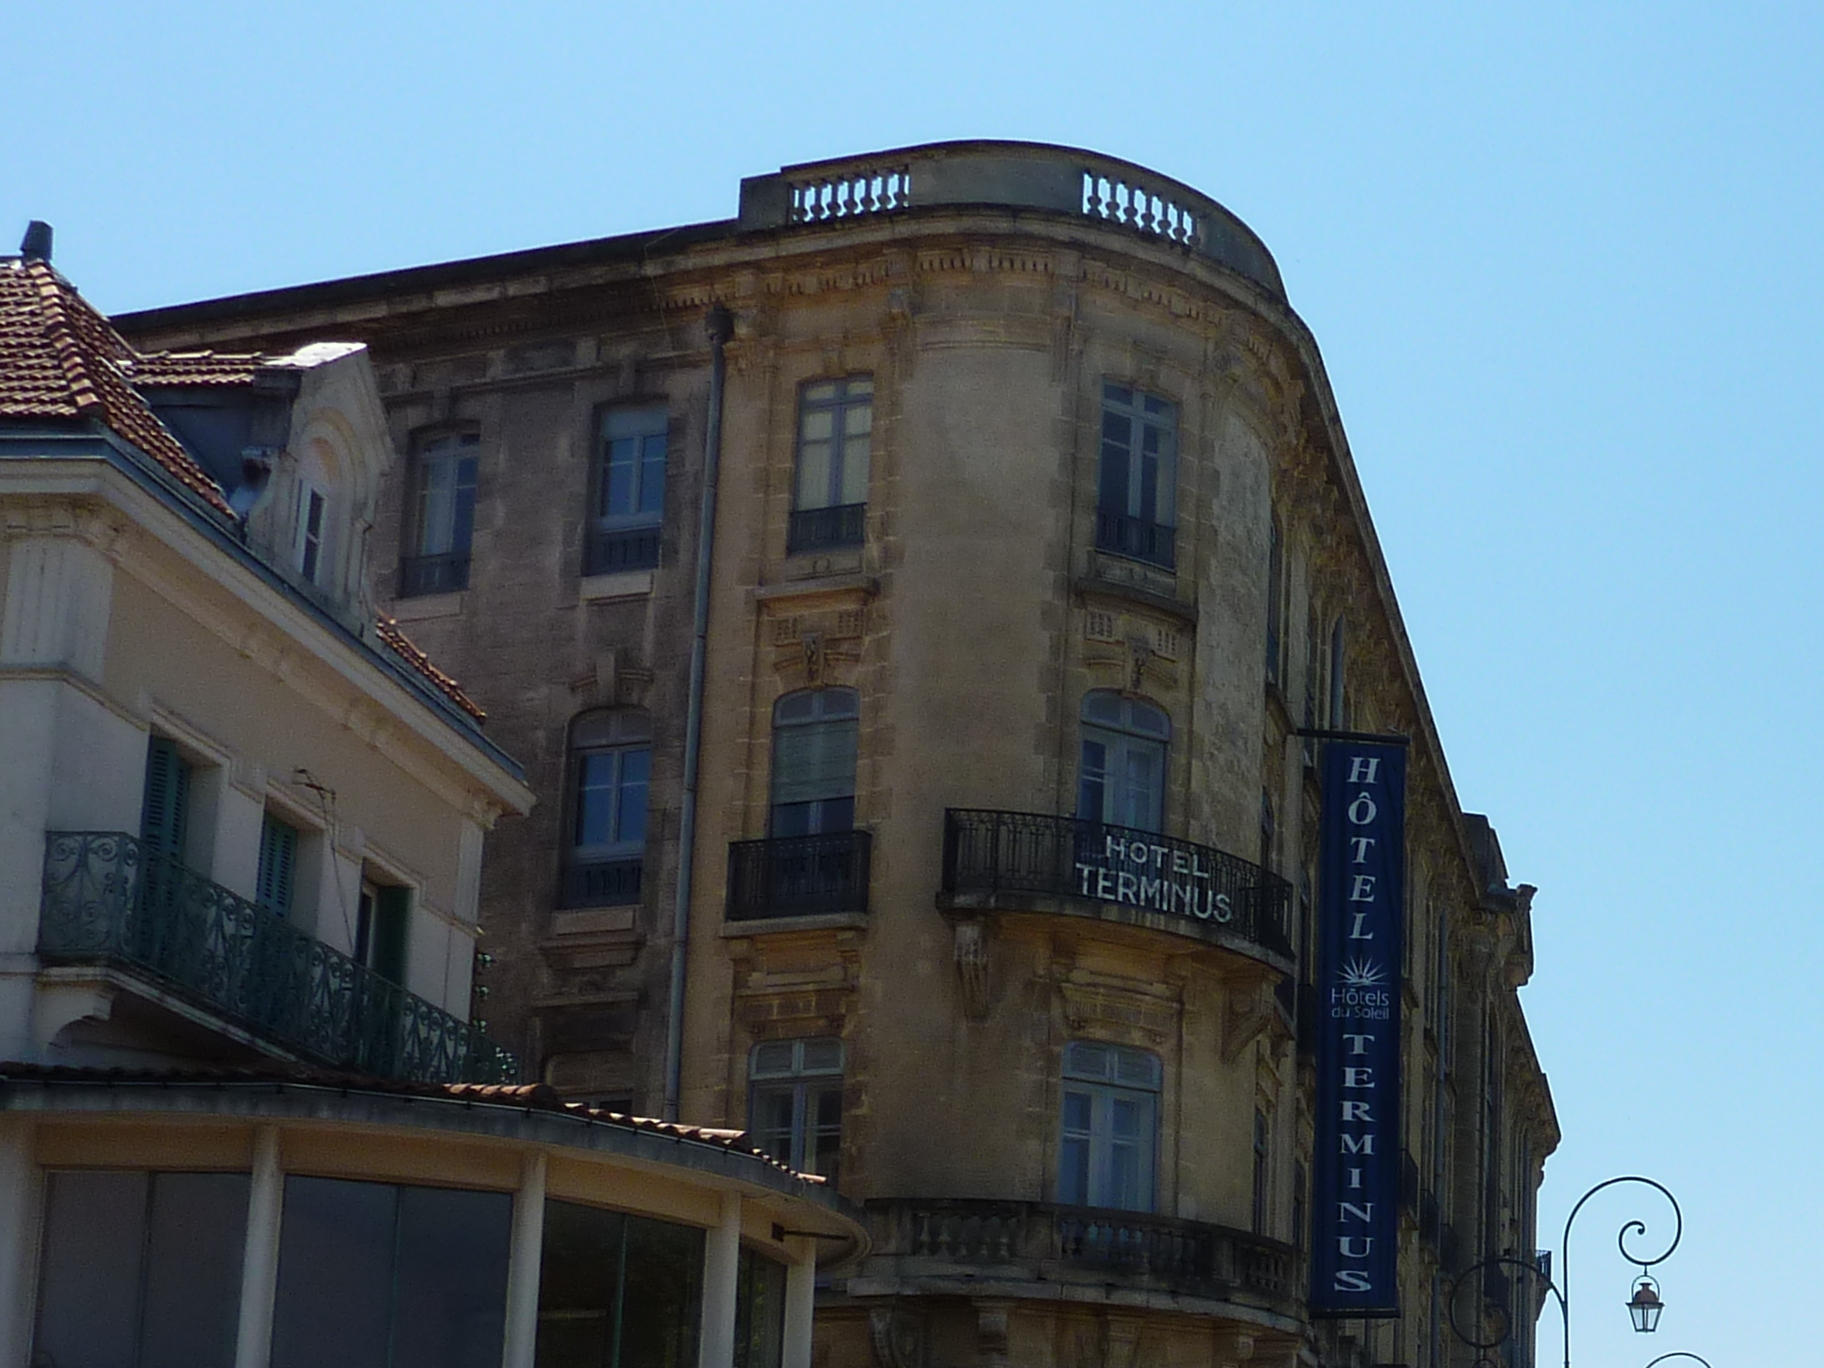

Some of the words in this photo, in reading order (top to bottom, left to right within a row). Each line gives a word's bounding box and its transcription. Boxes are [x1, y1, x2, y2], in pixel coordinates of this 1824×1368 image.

[1105, 835, 1210, 879] HOTEL
[1347, 755, 1381, 941] HÔTEL
[1075, 862, 1233, 924] TERMINUS
[1331, 987, 1390, 1007] Hôtels
[1331, 1006, 1350, 1018] du
[1354, 1006, 1390, 1020] Soleil
[1332, 1033, 1378, 1293] TERMINUS
